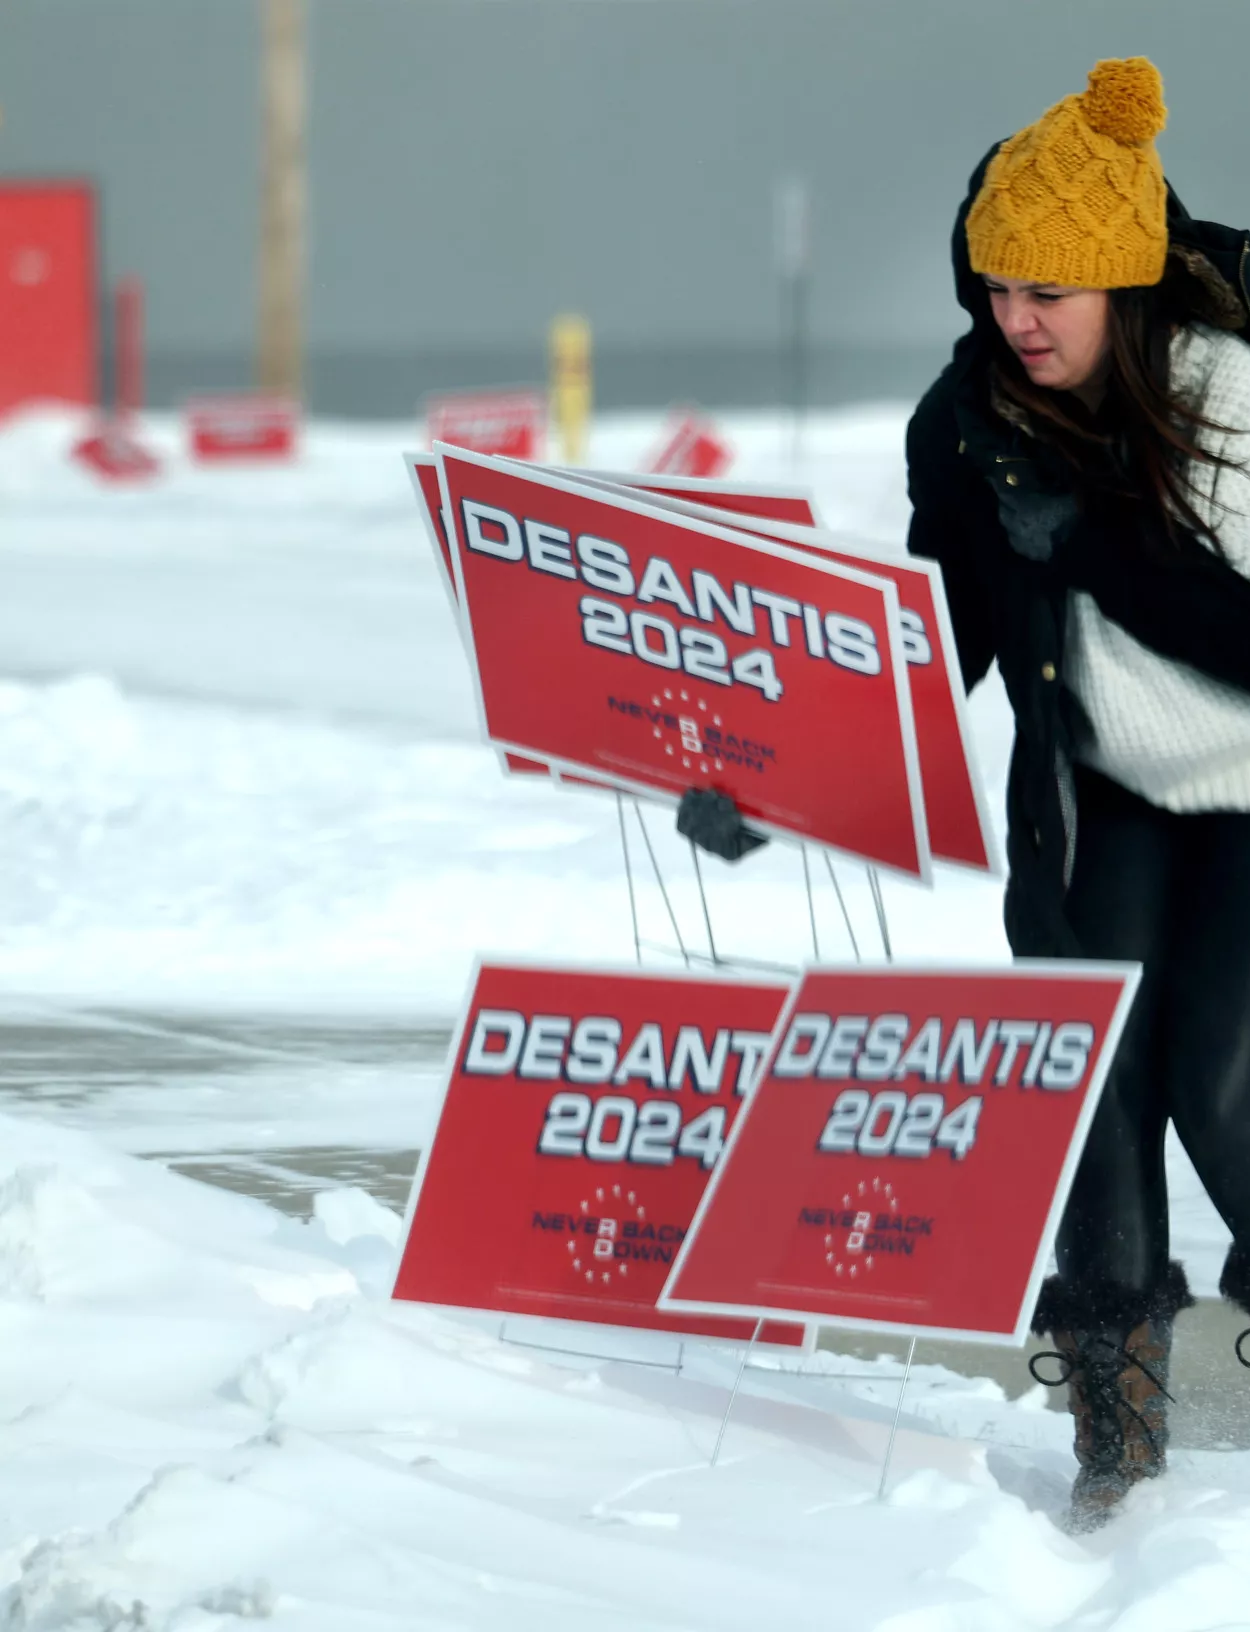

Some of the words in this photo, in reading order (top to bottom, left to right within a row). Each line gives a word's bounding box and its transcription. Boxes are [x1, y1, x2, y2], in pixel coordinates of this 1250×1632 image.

[460, 496, 882, 677] DESANTIS
[579, 594, 784, 702] 2024
[608, 696, 699, 738] NEVER
[703, 726, 777, 765] BACK
[681, 735, 765, 774] DOWN
[773, 1012, 1096, 1092] DESANTIS
[536, 1092, 726, 1171] 2024
[817, 1089, 984, 1161] 2024
[531, 1211, 618, 1239] NEVER
[593, 1238, 673, 1263] DOWN
[799, 1208, 871, 1232] NEVER
[873, 1213, 936, 1236] BACK
[846, 1231, 915, 1256] DOWN
